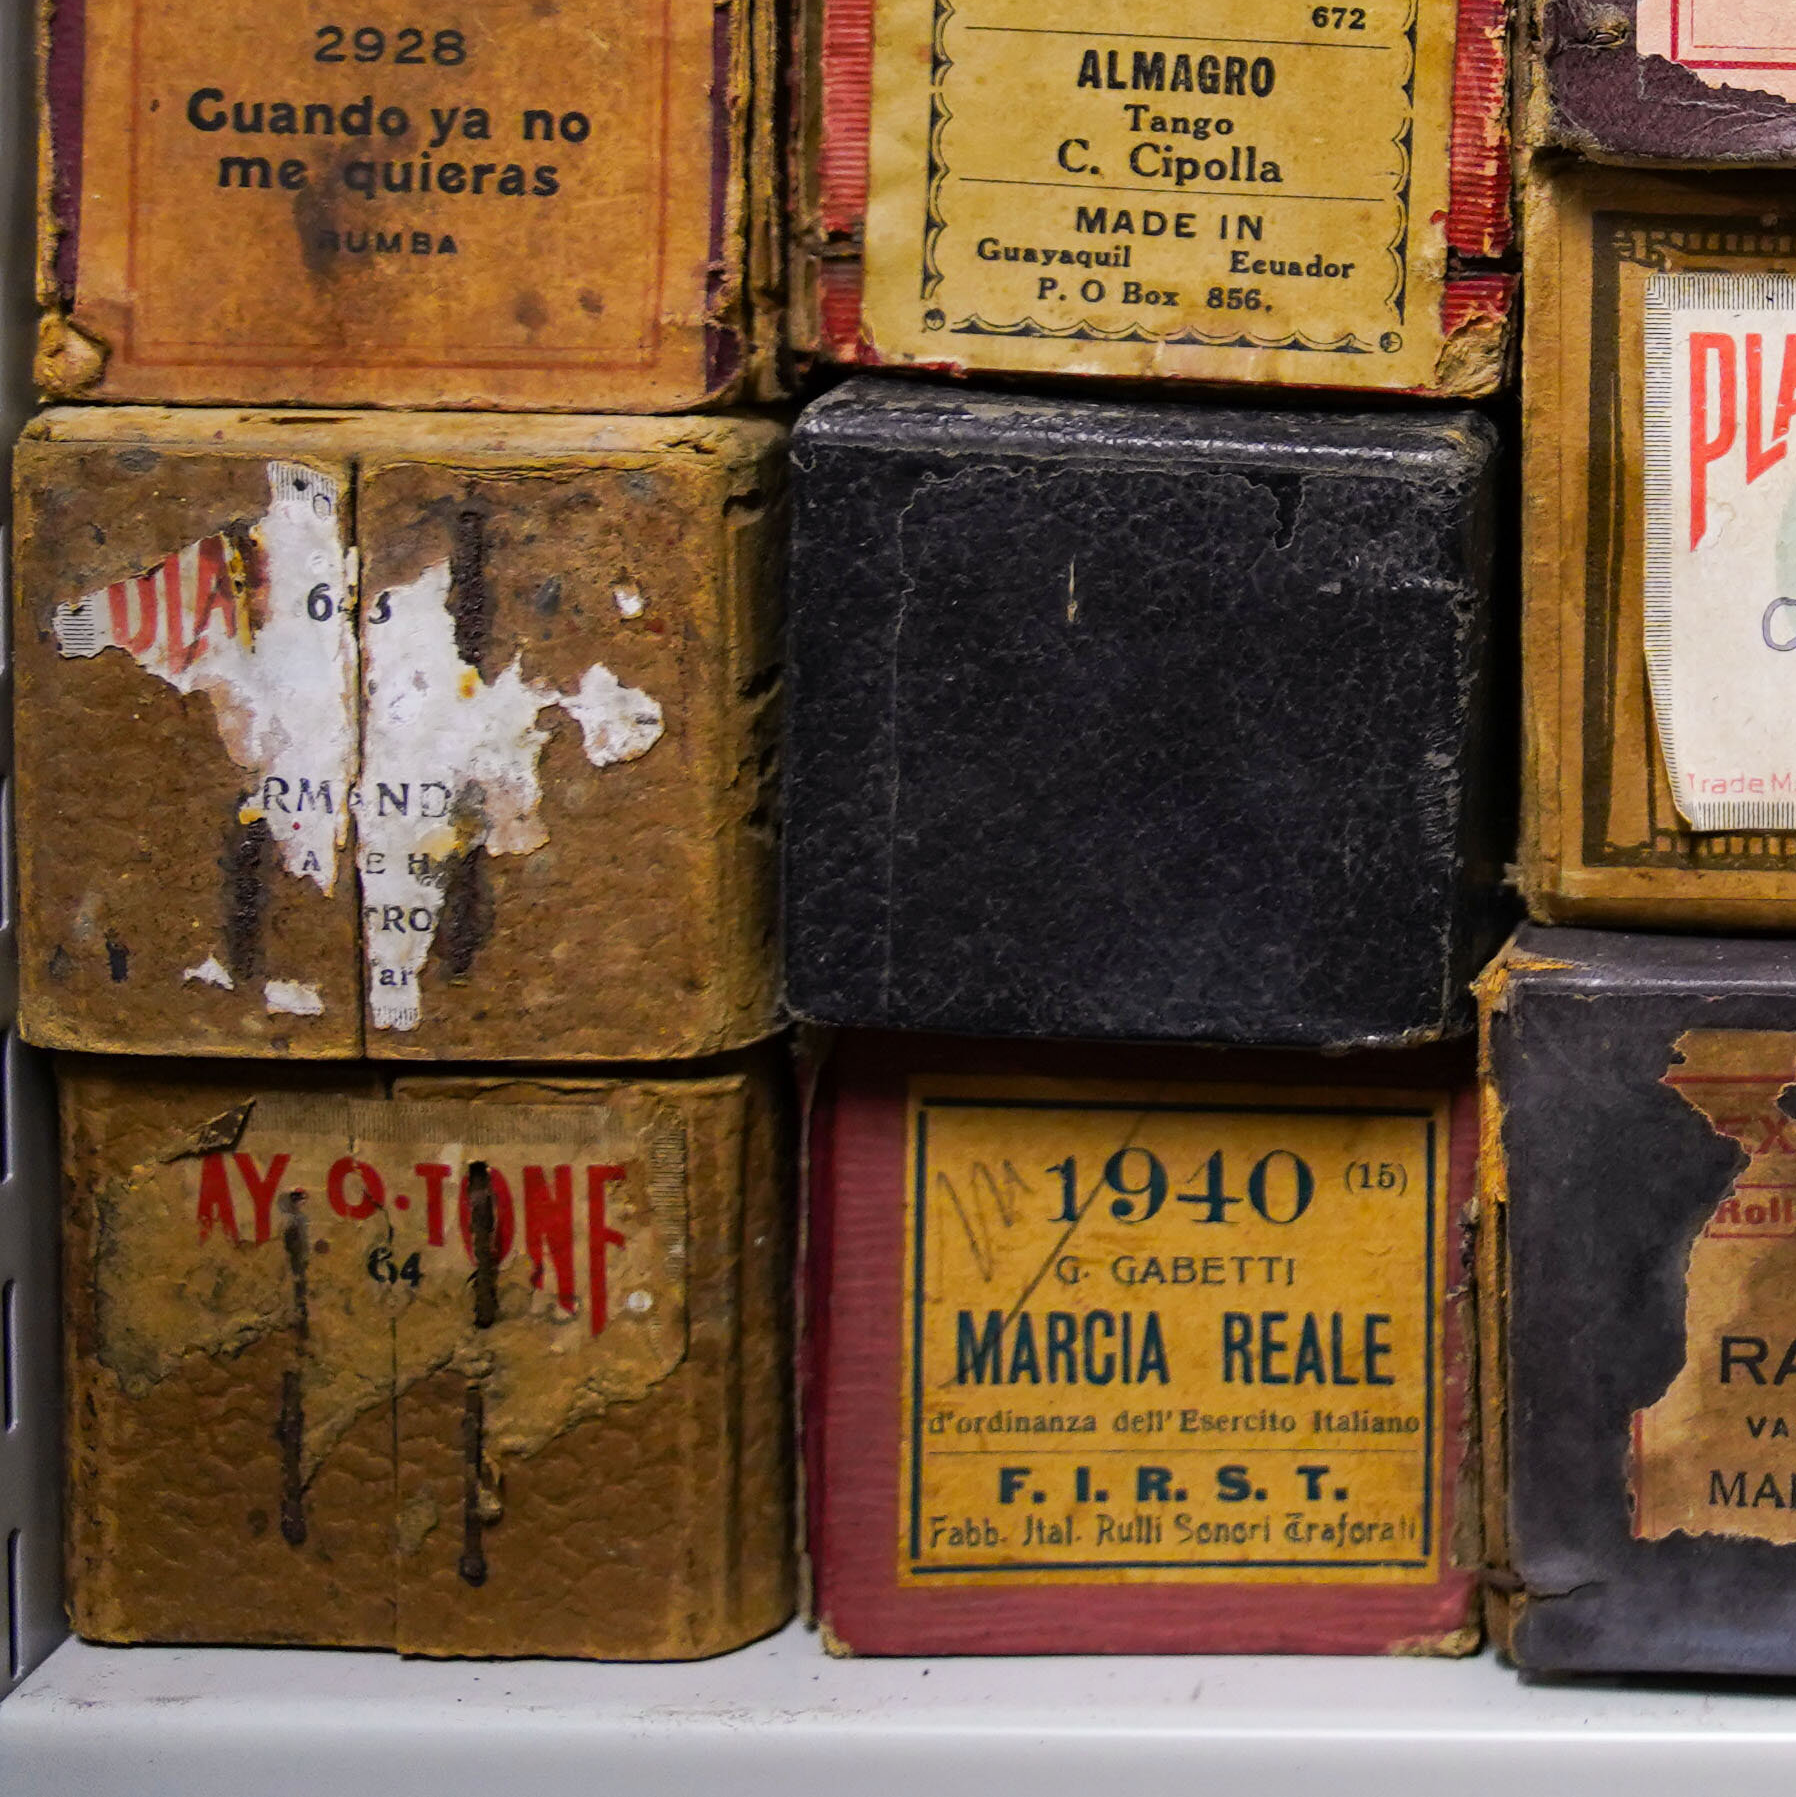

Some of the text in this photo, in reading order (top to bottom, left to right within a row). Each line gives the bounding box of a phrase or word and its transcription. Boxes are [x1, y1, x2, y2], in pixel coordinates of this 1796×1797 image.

[1312, 7, 1366, 30] 672
[313, 26, 466, 65] 2928
[1078, 49, 1275, 97] ALMAGRO
[187, 88, 591, 147] Cuando ya no
[1124, 104, 1234, 142] Tango
[218, 152, 561, 198] me quieras
[1047, 1148, 1314, 1225] 1940
[1344, 1162, 1407, 1197] (15)
[368, 1248, 423, 1286] 64
[957, 1309, 1394, 1386] MARCIA REALE
